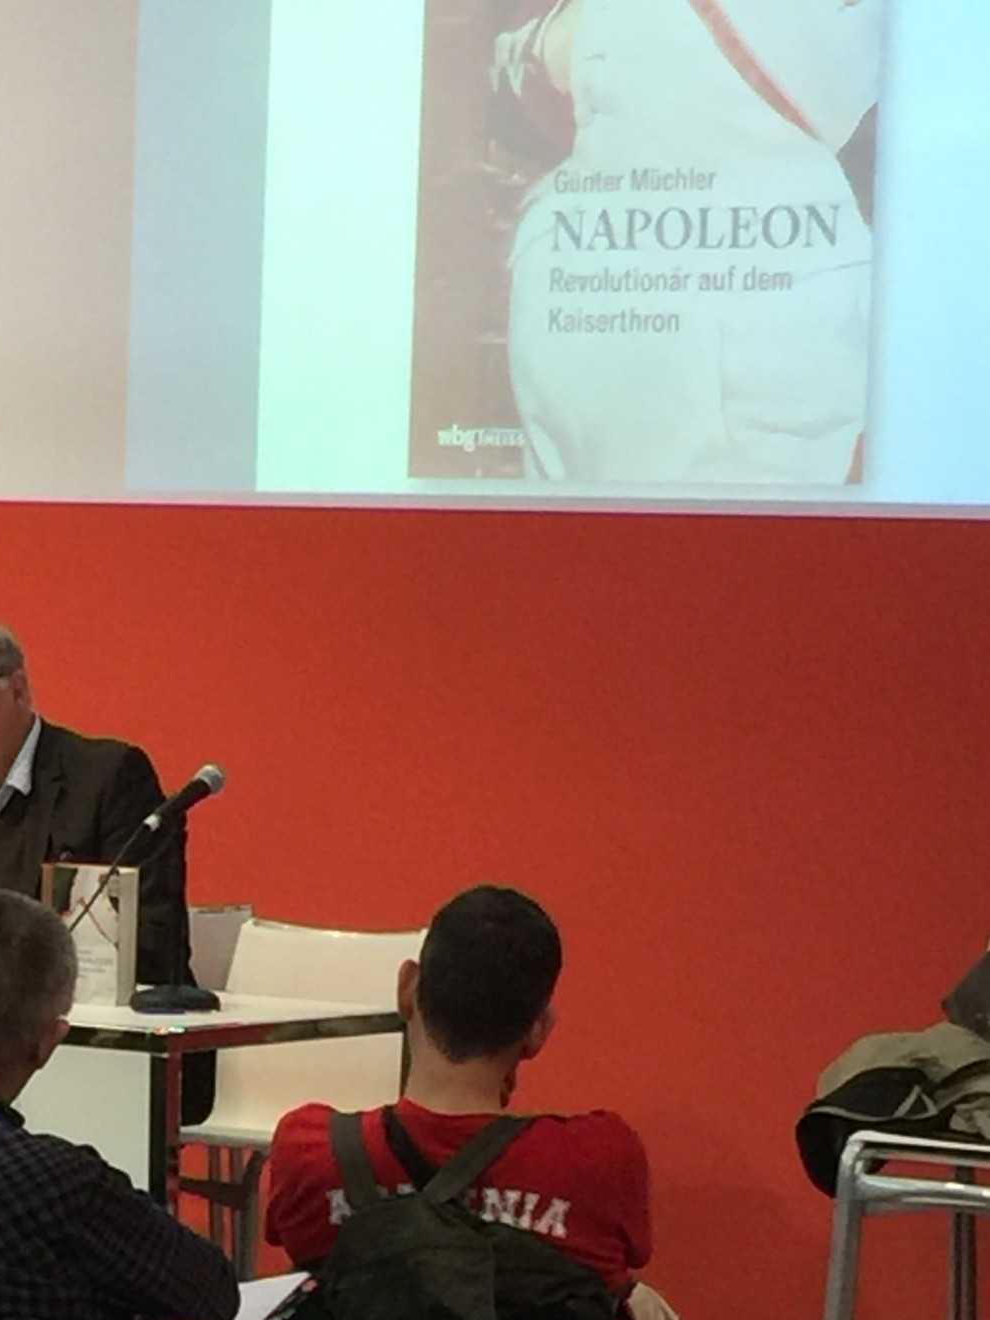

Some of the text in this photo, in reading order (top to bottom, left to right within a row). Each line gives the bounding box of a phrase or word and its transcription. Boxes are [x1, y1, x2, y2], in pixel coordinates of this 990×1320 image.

[554, 168, 717, 193] Günter Müchler
[551, 204, 840, 251] NAPOLEON
[549, 265, 793, 293] Revolutionär auf dem
[548, 307, 680, 333] Kaiserthron
